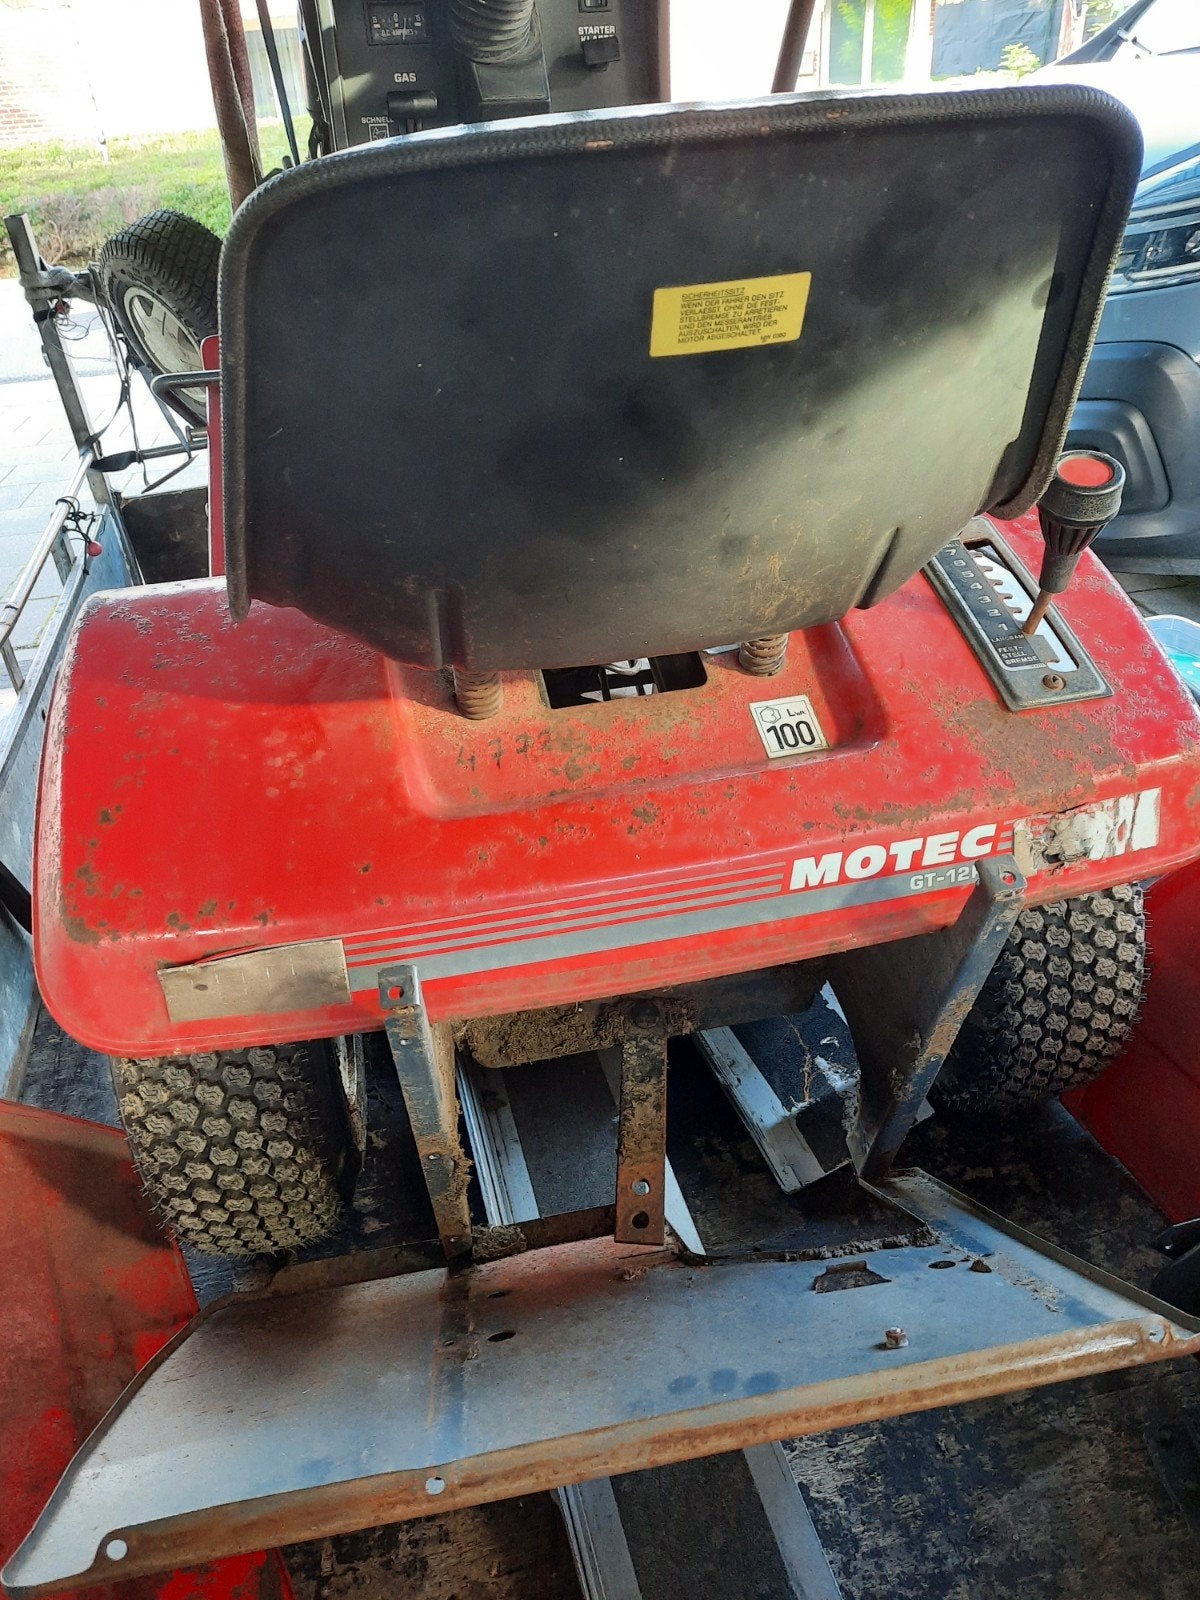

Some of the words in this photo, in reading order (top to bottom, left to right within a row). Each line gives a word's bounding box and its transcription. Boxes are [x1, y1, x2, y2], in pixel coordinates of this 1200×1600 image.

[578, 26, 616, 35] STARTER
[394, 72, 416, 82] GAS
[681, 287, 745, 300] SICHERHEITSSITZ
[680, 300, 702, 309] WENN
[721, 295, 749, 304] FAHRER
[723, 303, 743, 311] OHNE
[679, 311, 729, 323] STELLBREMSE
[744, 304, 787, 315] ARRETIEREN
[714, 313, 772, 326] MESSERANTRIEB
[742, 321, 761, 329] WIRD
[677, 335, 704, 344] MOTOR
[978, 595, 992, 604] 3
[987, 608, 1002, 617] 2
[1002, 651, 1027, 659] STELL
[1005, 656, 1038, 664] BREMSE
[766, 720, 816, 750] 100
[790, 824, 996, 890] MOTEC
